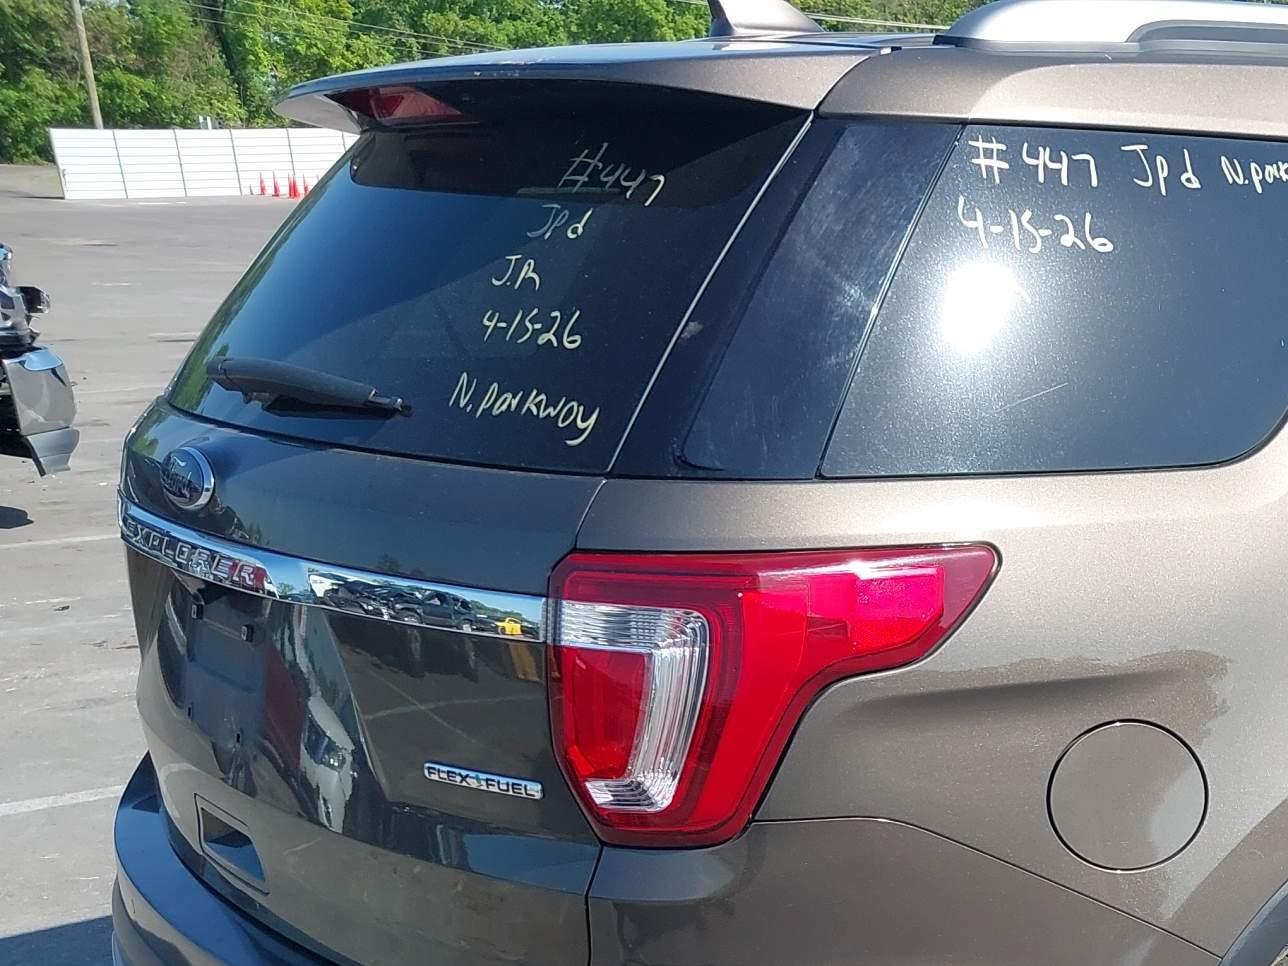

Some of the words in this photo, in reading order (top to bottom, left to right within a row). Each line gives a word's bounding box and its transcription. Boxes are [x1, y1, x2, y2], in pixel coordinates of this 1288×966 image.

[124, 519, 255, 587] EXPLORER
[425, 765, 472, 786] FLEX
[485, 777, 537, 798] FUEL
